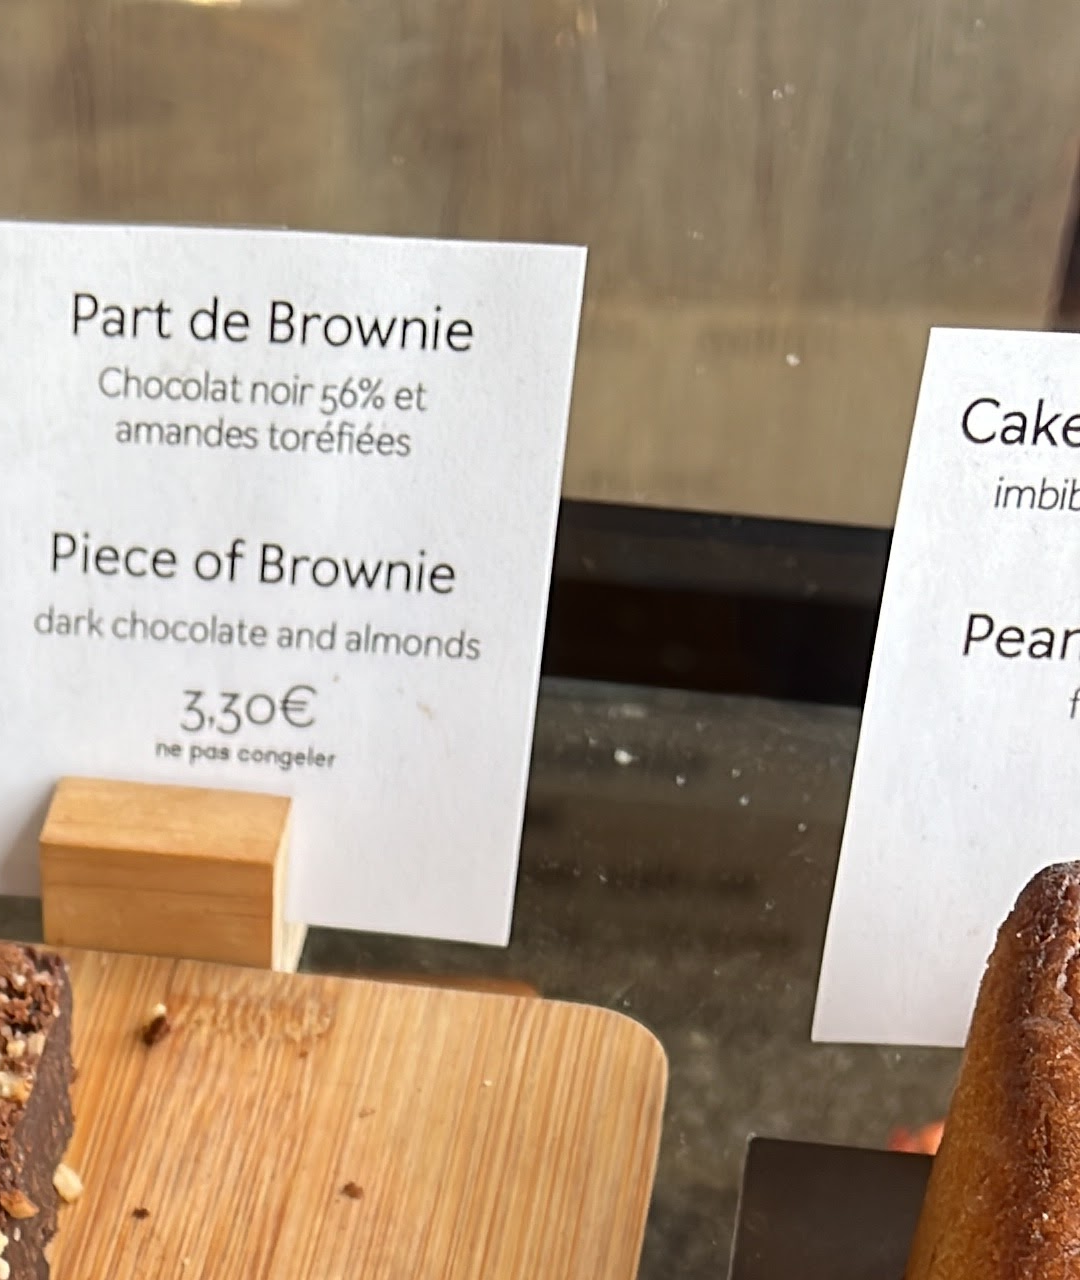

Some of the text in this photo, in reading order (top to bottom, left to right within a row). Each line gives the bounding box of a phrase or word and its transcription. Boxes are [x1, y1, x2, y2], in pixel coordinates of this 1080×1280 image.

[72, 293, 474, 352] Part de Brownie
[98, 367, 427, 415] Chocolat noir 56% et
[115, 418, 411, 457] amandes toréfiées
[961, 397, 1080, 448] Cake
[51, 532, 455, 594] Piece of Brownie
[34, 606, 481, 660] dark chocolate and almonds
[180, 684, 318, 735] 3,30€
[155, 742, 336, 771] ne pas congeler
